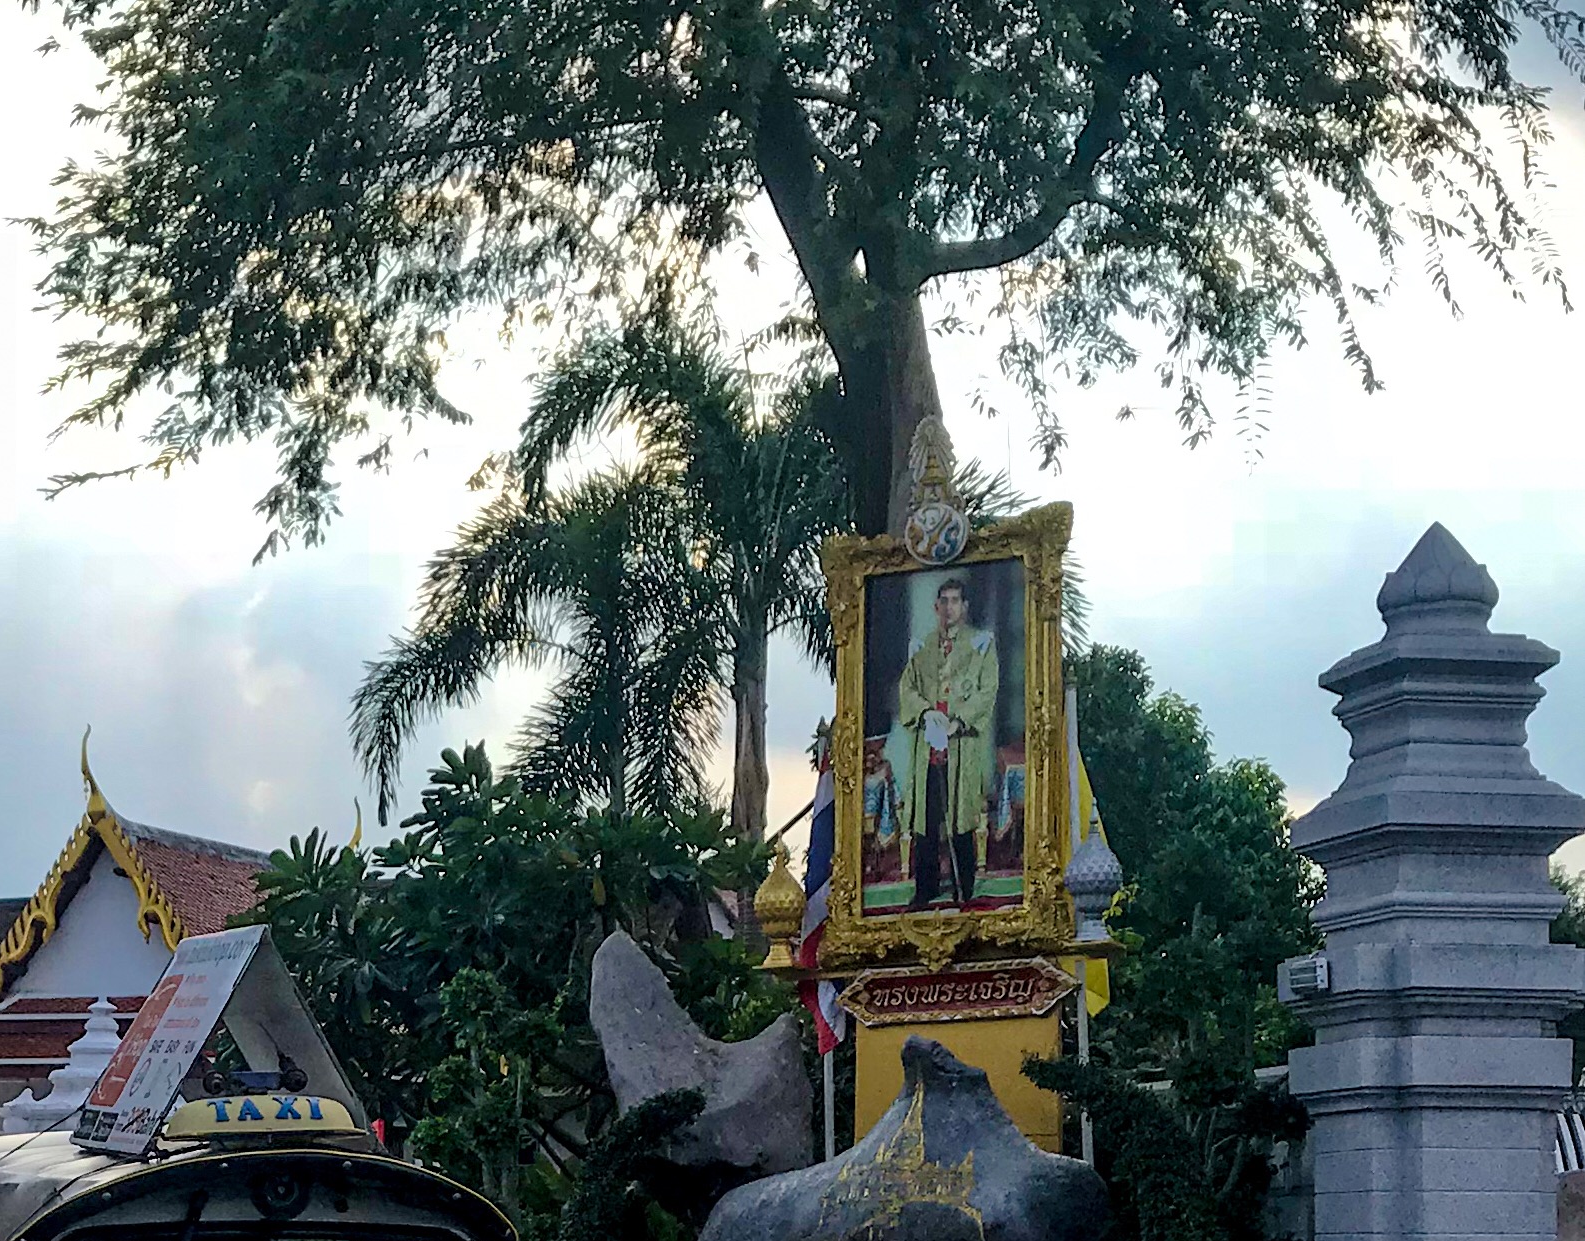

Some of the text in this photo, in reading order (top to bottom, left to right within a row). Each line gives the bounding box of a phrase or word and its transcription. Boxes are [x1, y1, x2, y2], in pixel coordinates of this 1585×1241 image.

[872, 973, 1037, 1007] ทรงพระเจริญ
[206, 1096, 324, 1123] TAXI
